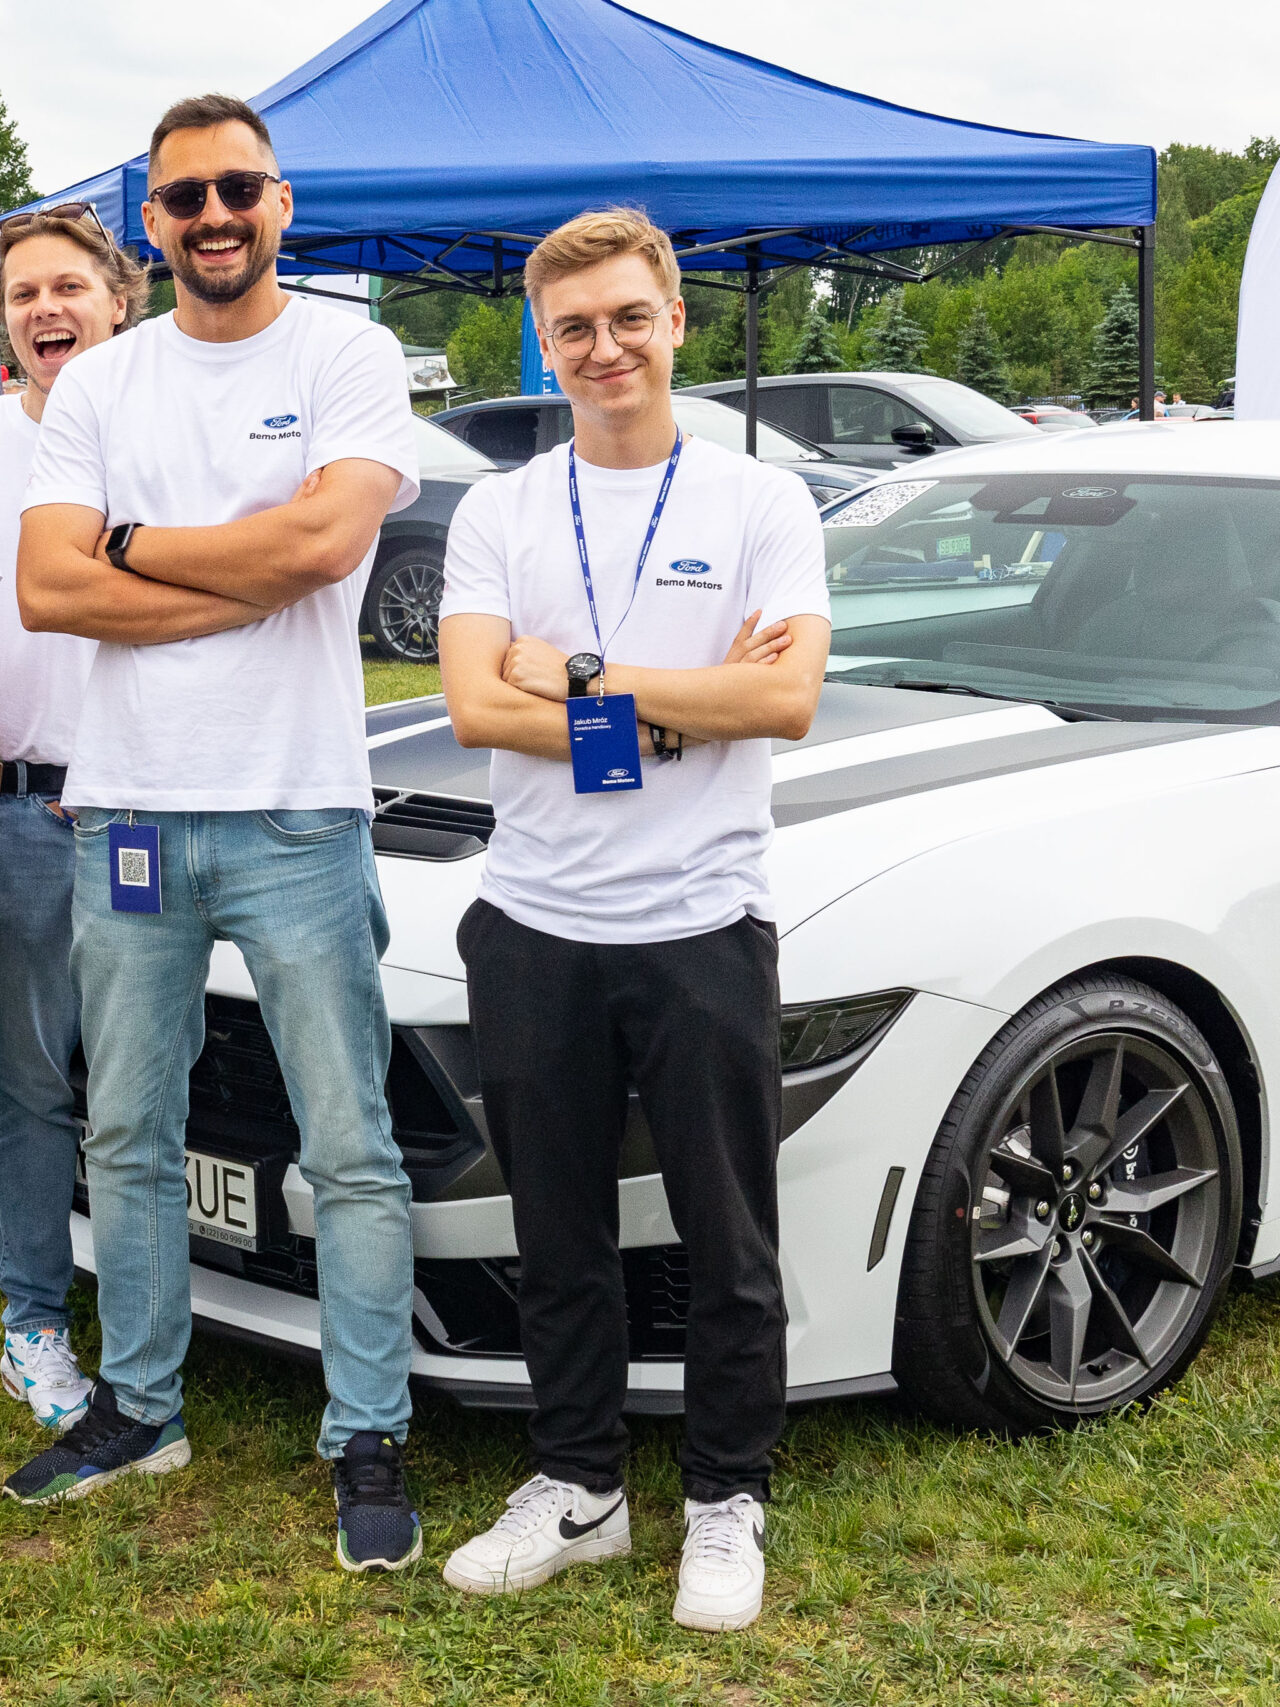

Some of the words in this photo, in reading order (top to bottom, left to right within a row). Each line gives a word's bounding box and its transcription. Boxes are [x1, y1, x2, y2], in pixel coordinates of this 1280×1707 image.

[269, 416, 293, 427] Ford
[249, 432, 277, 440] Bemo
[1069, 487, 1110, 498] Ford
[676, 560, 705, 573] Ford
[656, 578, 685, 587] Bemo
[687, 579, 723, 591] Motors
[574, 718, 592, 726] Jakub
[592, 716, 608, 724] Mróz
[1109, 1000, 1124, 1011] P
[206, 1228, 219, 1237] (22)
[220, 1231, 229, 1241] 60
[230, 1233, 242, 1244] 999
[243, 1238, 253, 1248] 00
